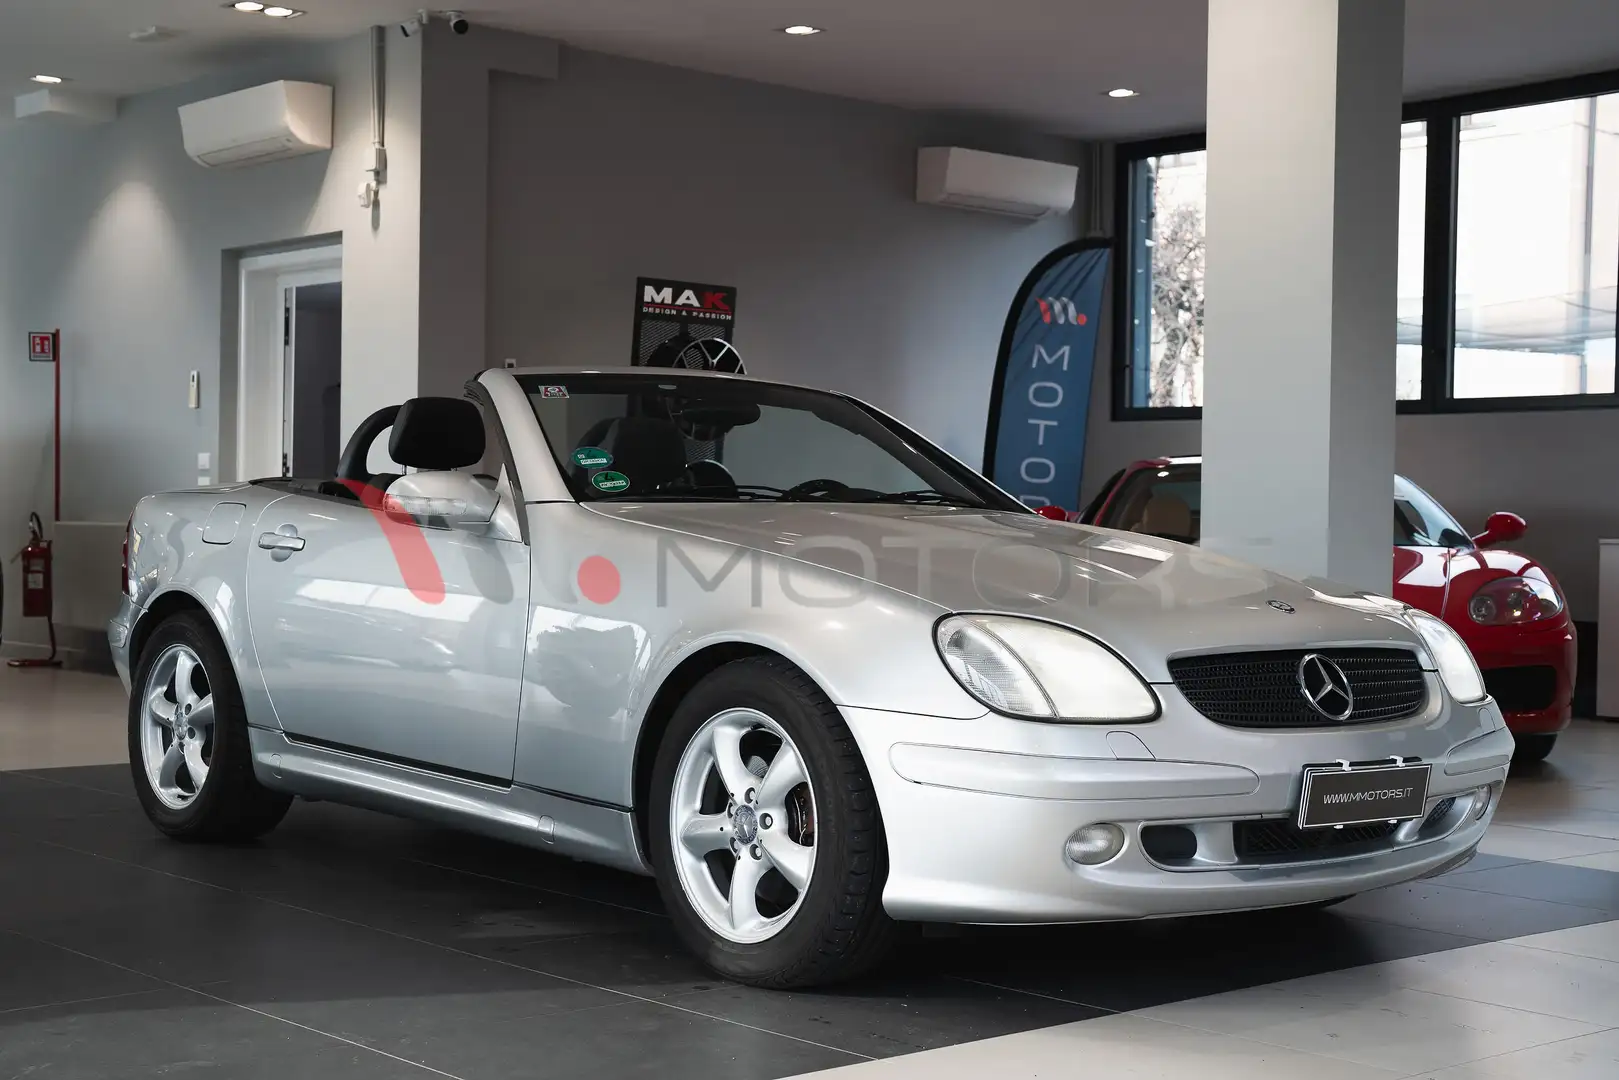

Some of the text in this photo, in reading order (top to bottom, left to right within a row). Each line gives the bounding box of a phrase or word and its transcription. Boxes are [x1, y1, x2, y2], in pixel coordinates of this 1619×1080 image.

[643, 285, 729, 310] MAK
[643, 307, 677, 315] DESIGN
[693, 312, 731, 320] PASSION
[1323, 787, 1413, 804] WWW.MMOTORS.IT
